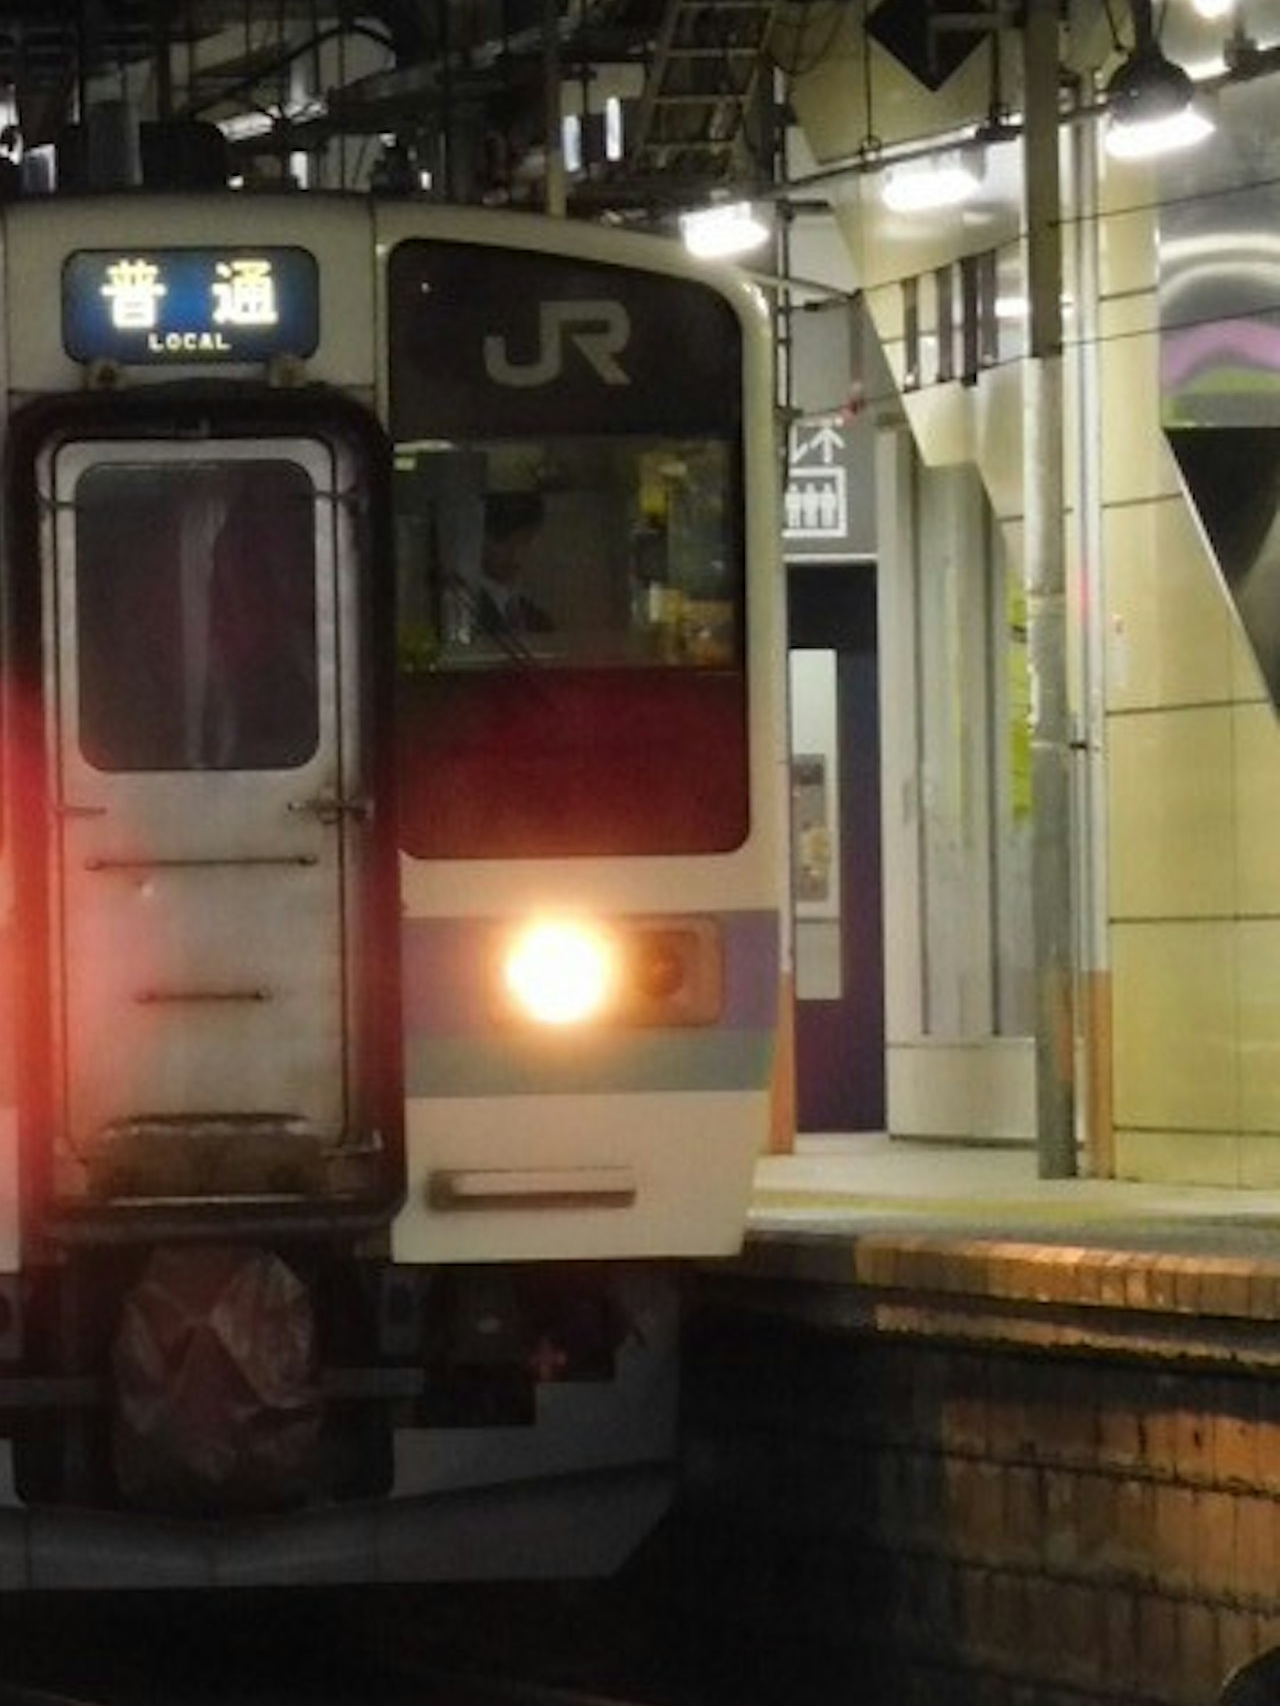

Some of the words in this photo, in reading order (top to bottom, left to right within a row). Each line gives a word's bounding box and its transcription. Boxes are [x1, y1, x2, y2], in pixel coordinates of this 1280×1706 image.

[100, 259, 279, 329] 普通
[147, 332, 232, 353] LOCAL
[482, 300, 633, 387] JR
